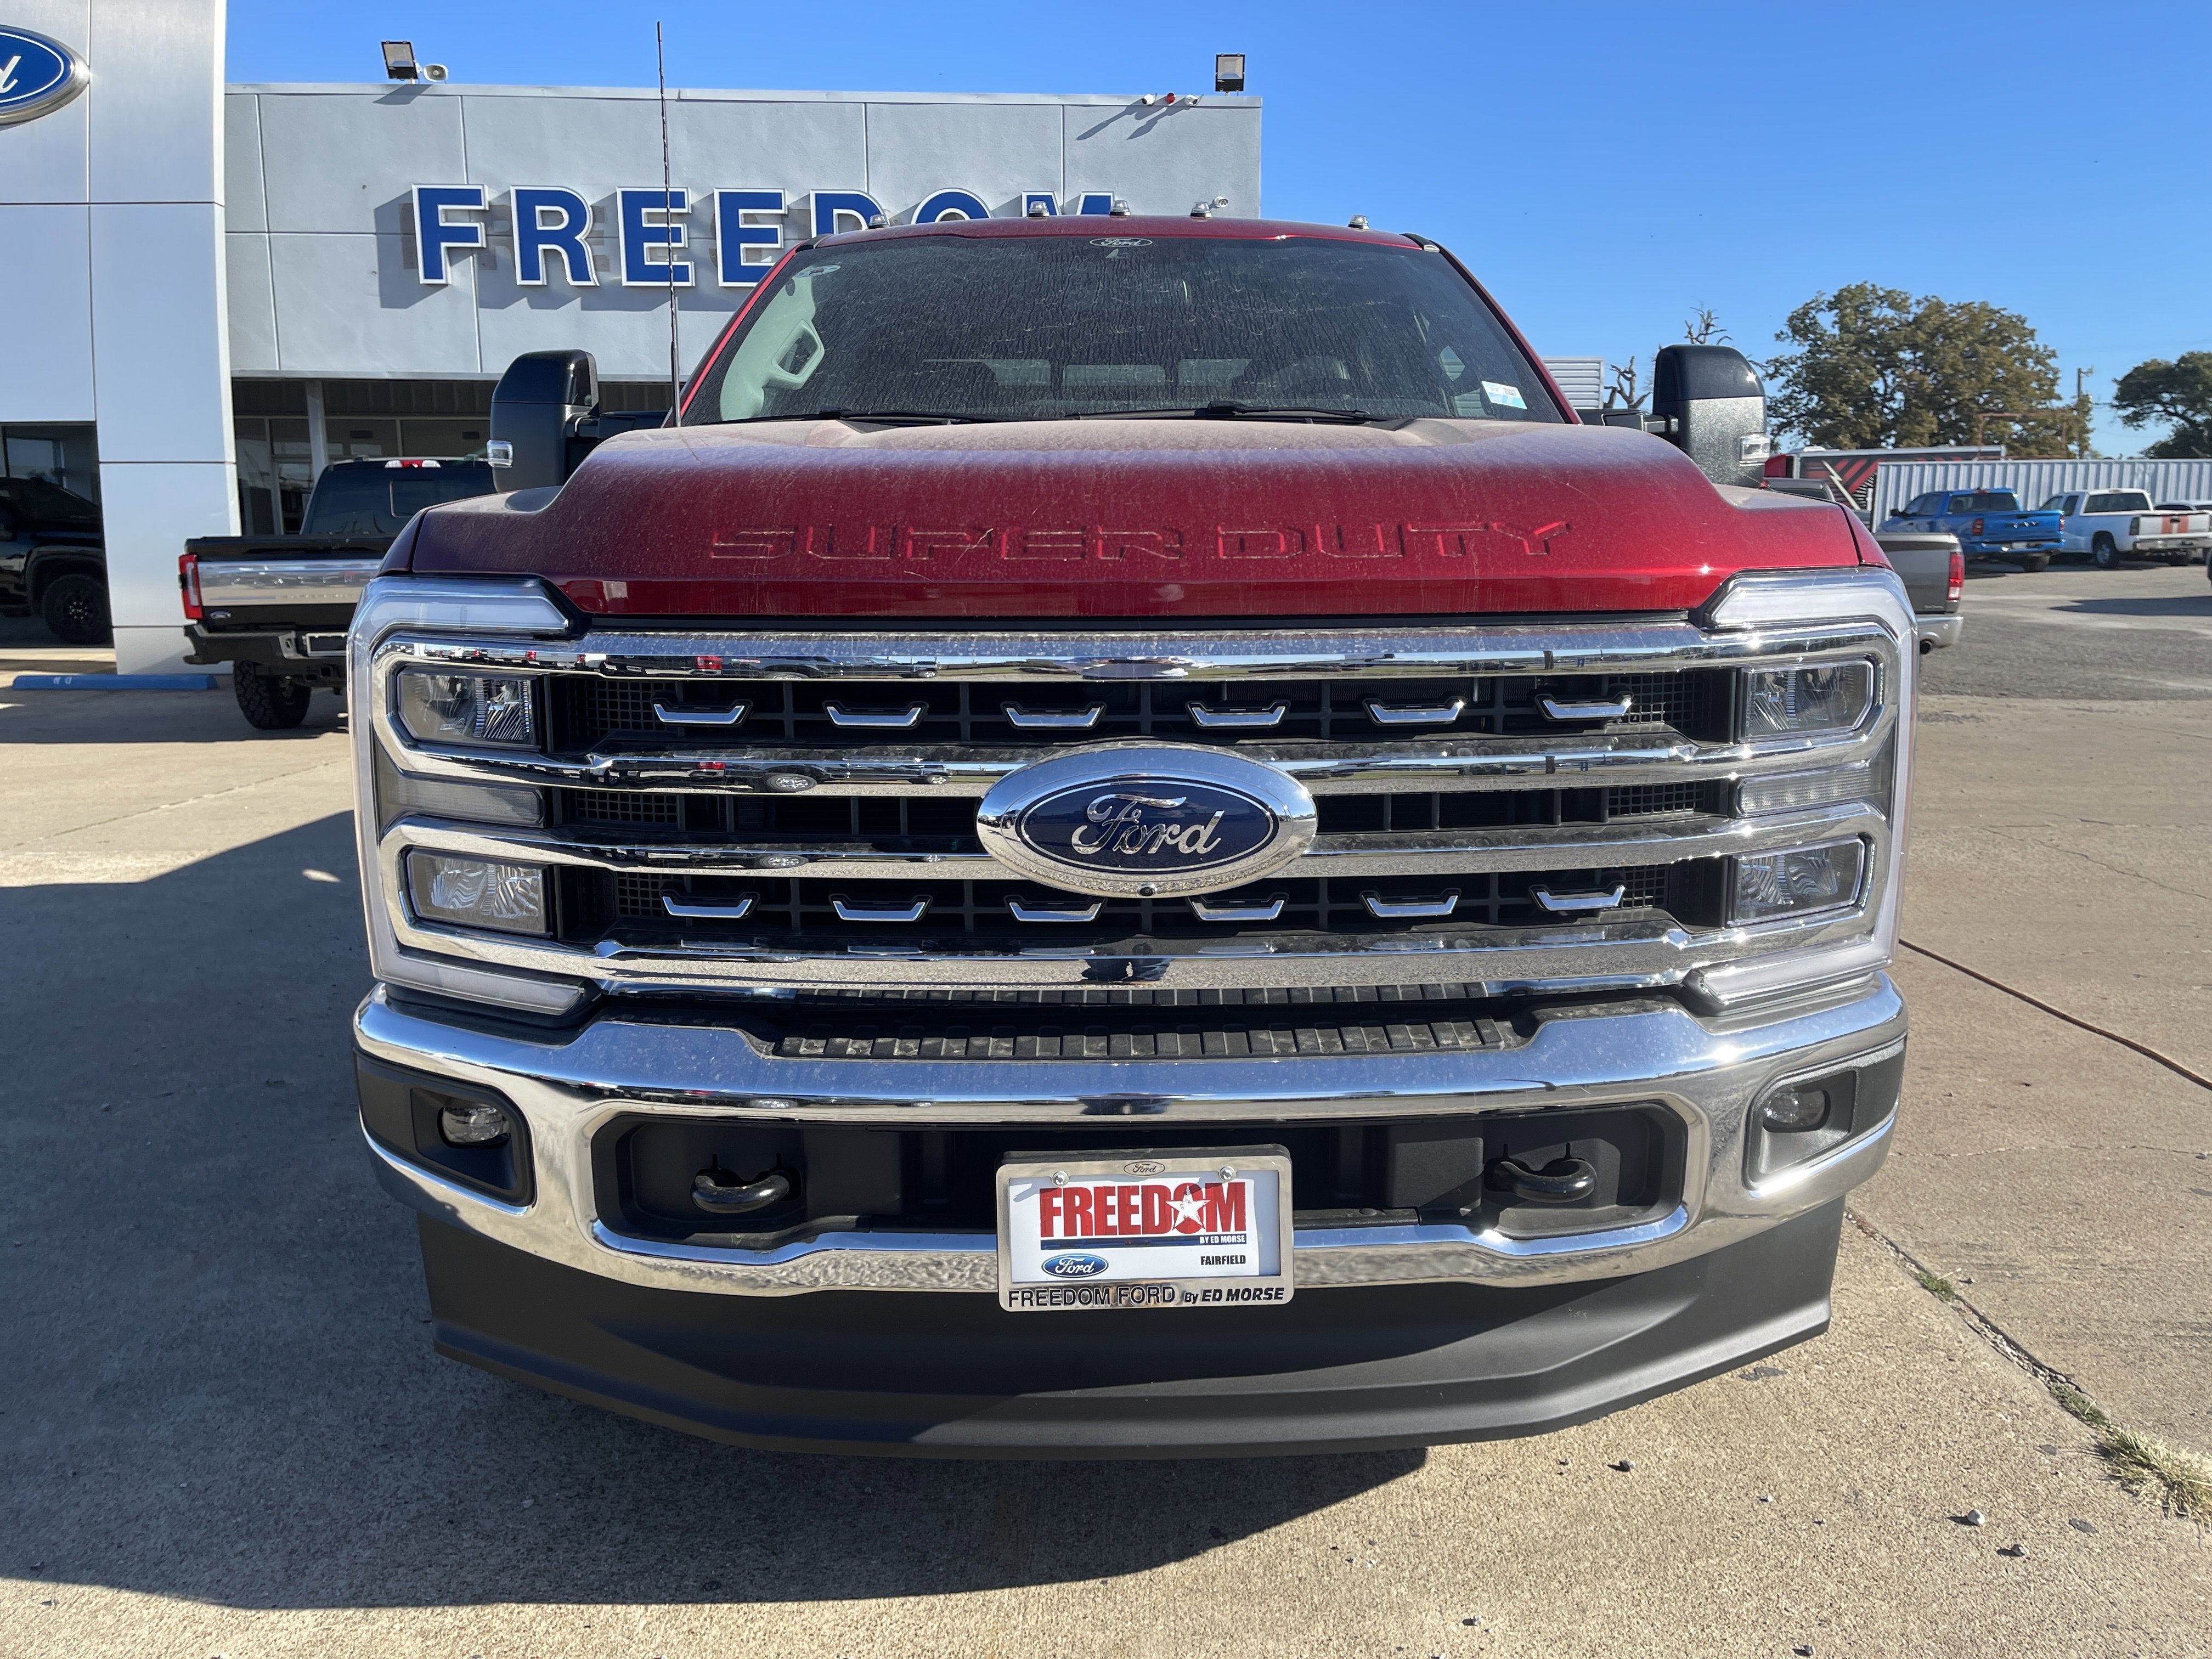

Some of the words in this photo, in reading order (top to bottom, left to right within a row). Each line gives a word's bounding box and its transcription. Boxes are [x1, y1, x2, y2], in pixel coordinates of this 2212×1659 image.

[710, 524, 1183, 561] SUPER
[1217, 521, 1572, 559] DUTY
[1071, 793, 1226, 854] Ford
[1132, 1163, 1156, 1173] Ford
[1040, 1182, 1245, 1238] FREEDOM
[1221, 1235, 1245, 1244] MORSE
[1055, 1258, 1094, 1274] Ford
[1200, 1254, 1246, 1266] FAIRFIELD
[1008, 1288, 1110, 1307] FREEDOM
[1118, 1286, 1175, 1304] FORD
[1201, 1289, 1222, 1302] ED
[1226, 1286, 1284, 1301] MORSE
